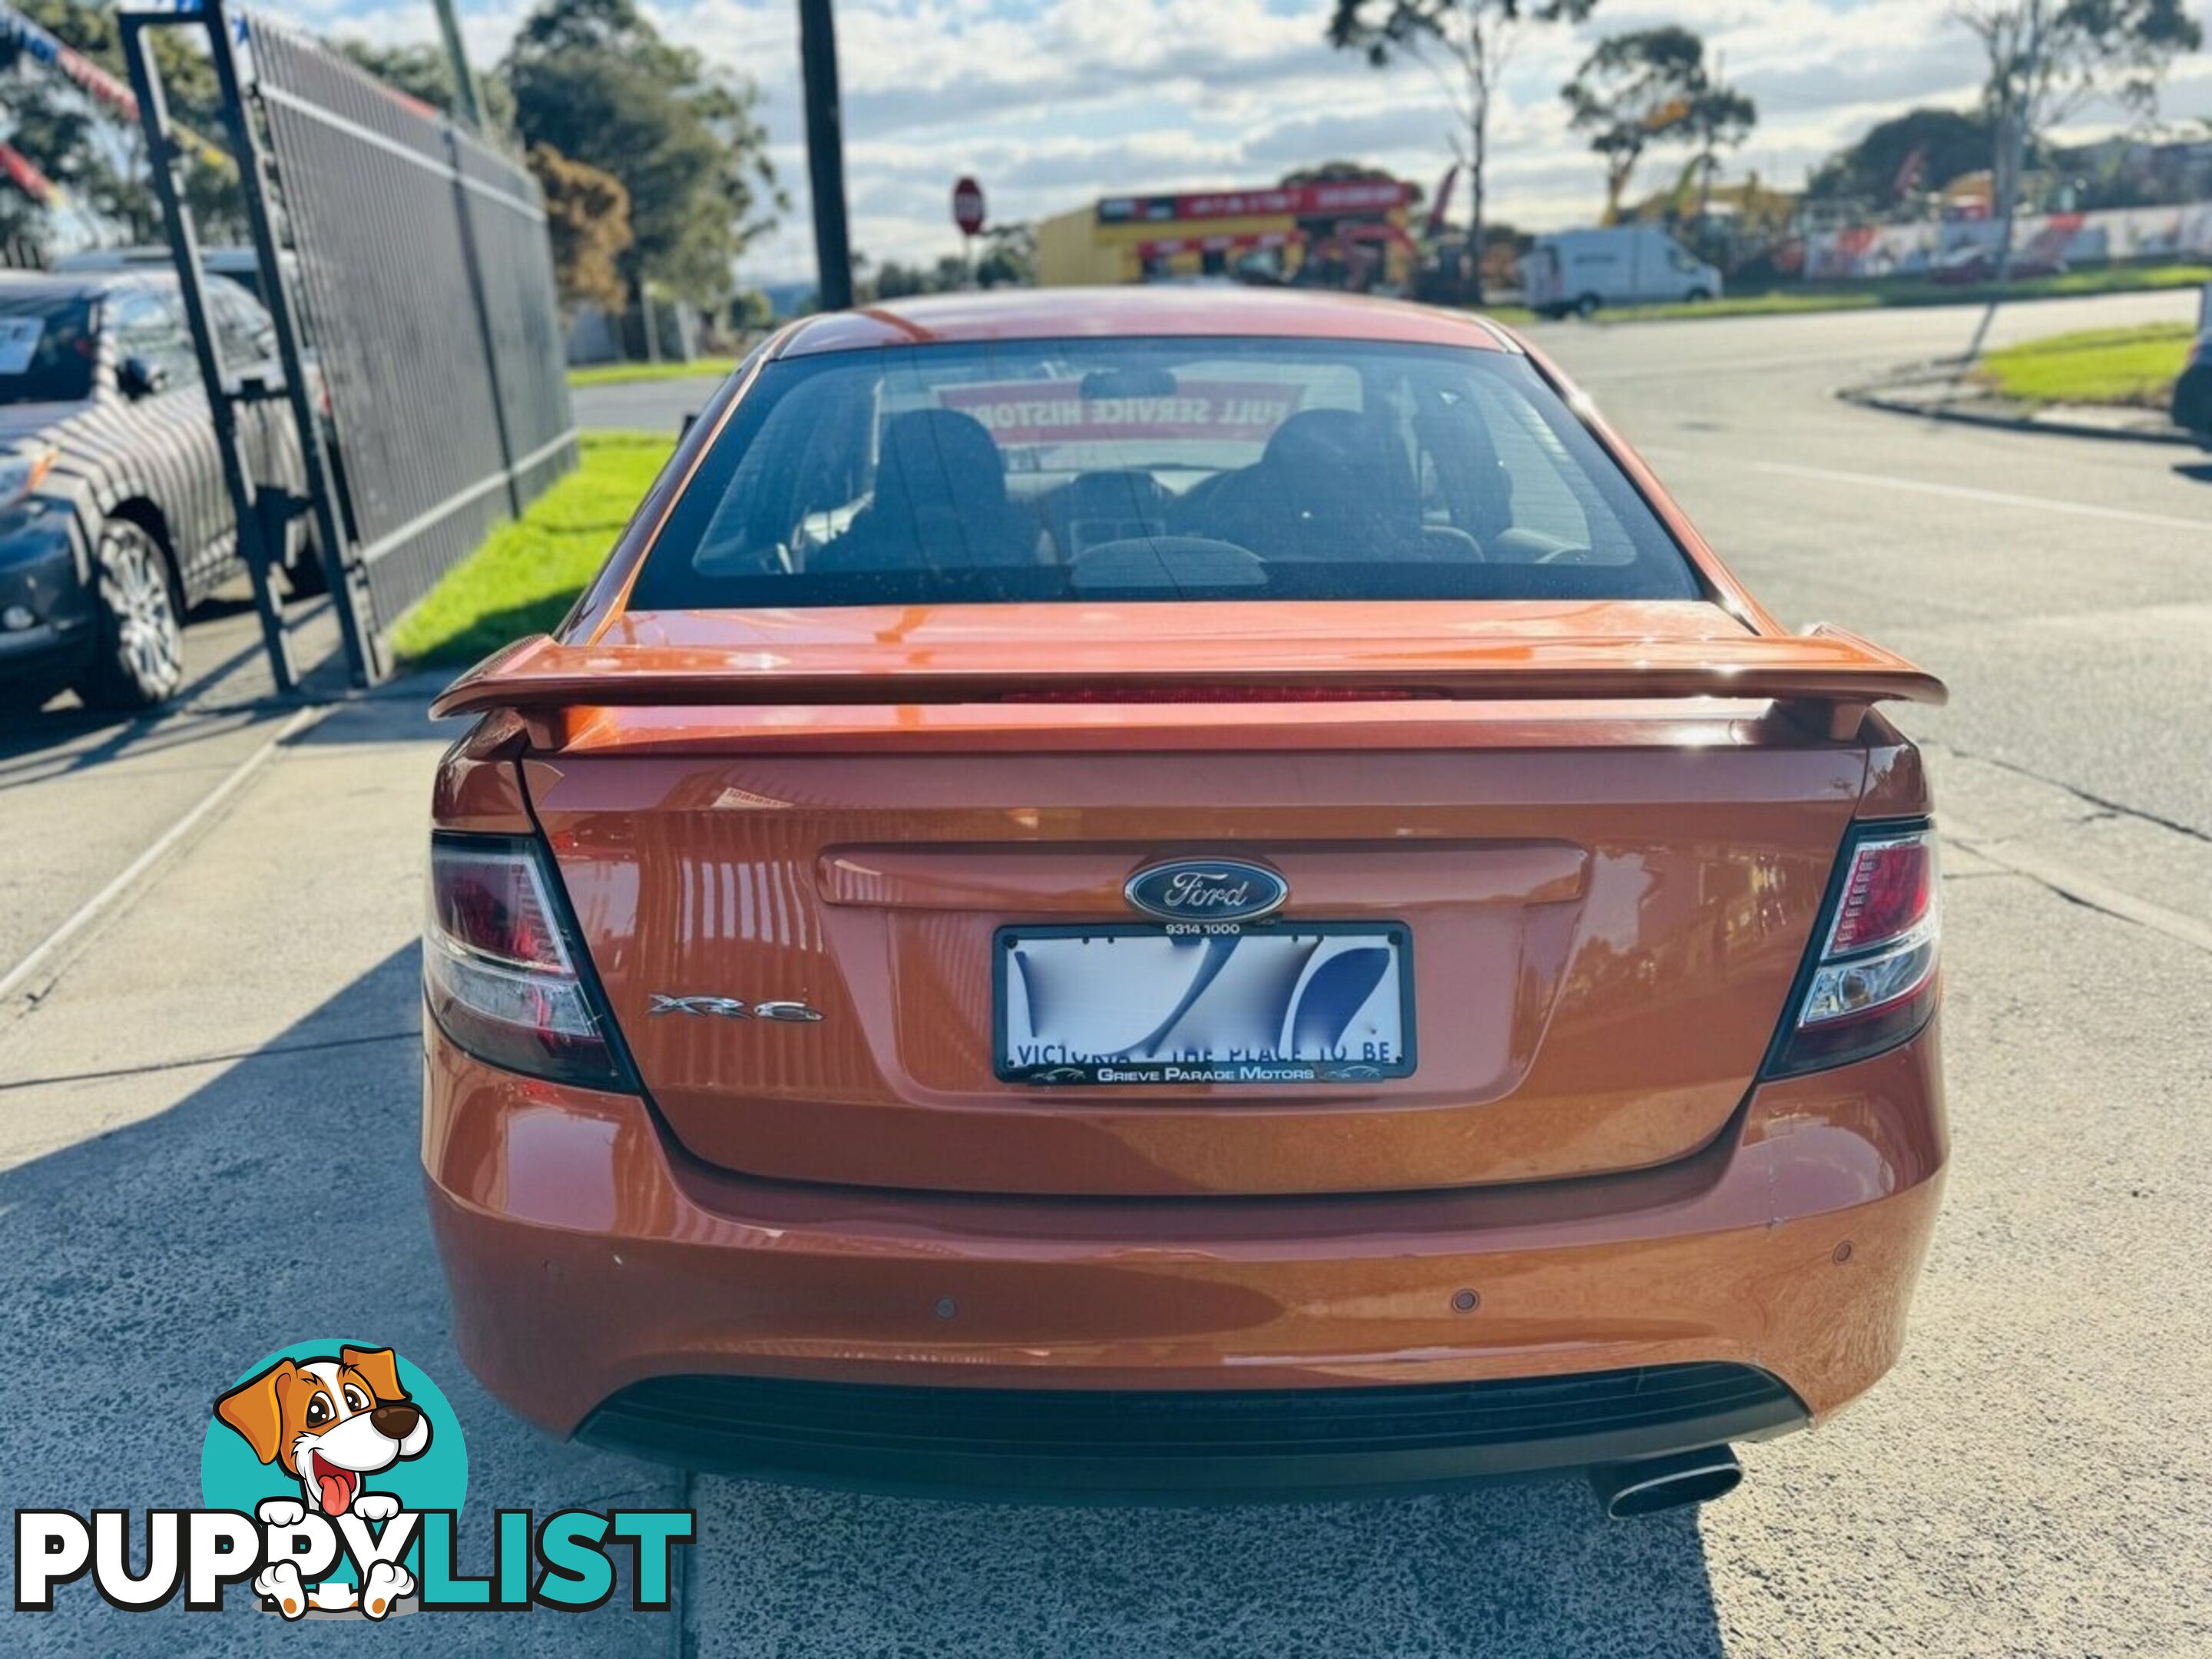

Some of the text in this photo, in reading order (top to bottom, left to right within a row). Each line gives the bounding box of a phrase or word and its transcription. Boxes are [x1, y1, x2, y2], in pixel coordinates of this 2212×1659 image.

[1164, 871, 1249, 906] Ford
[1165, 923, 1240, 935] 9314 1000
[645, 994, 824, 1021] XR6
[1363, 1041, 1391, 1063] BE
